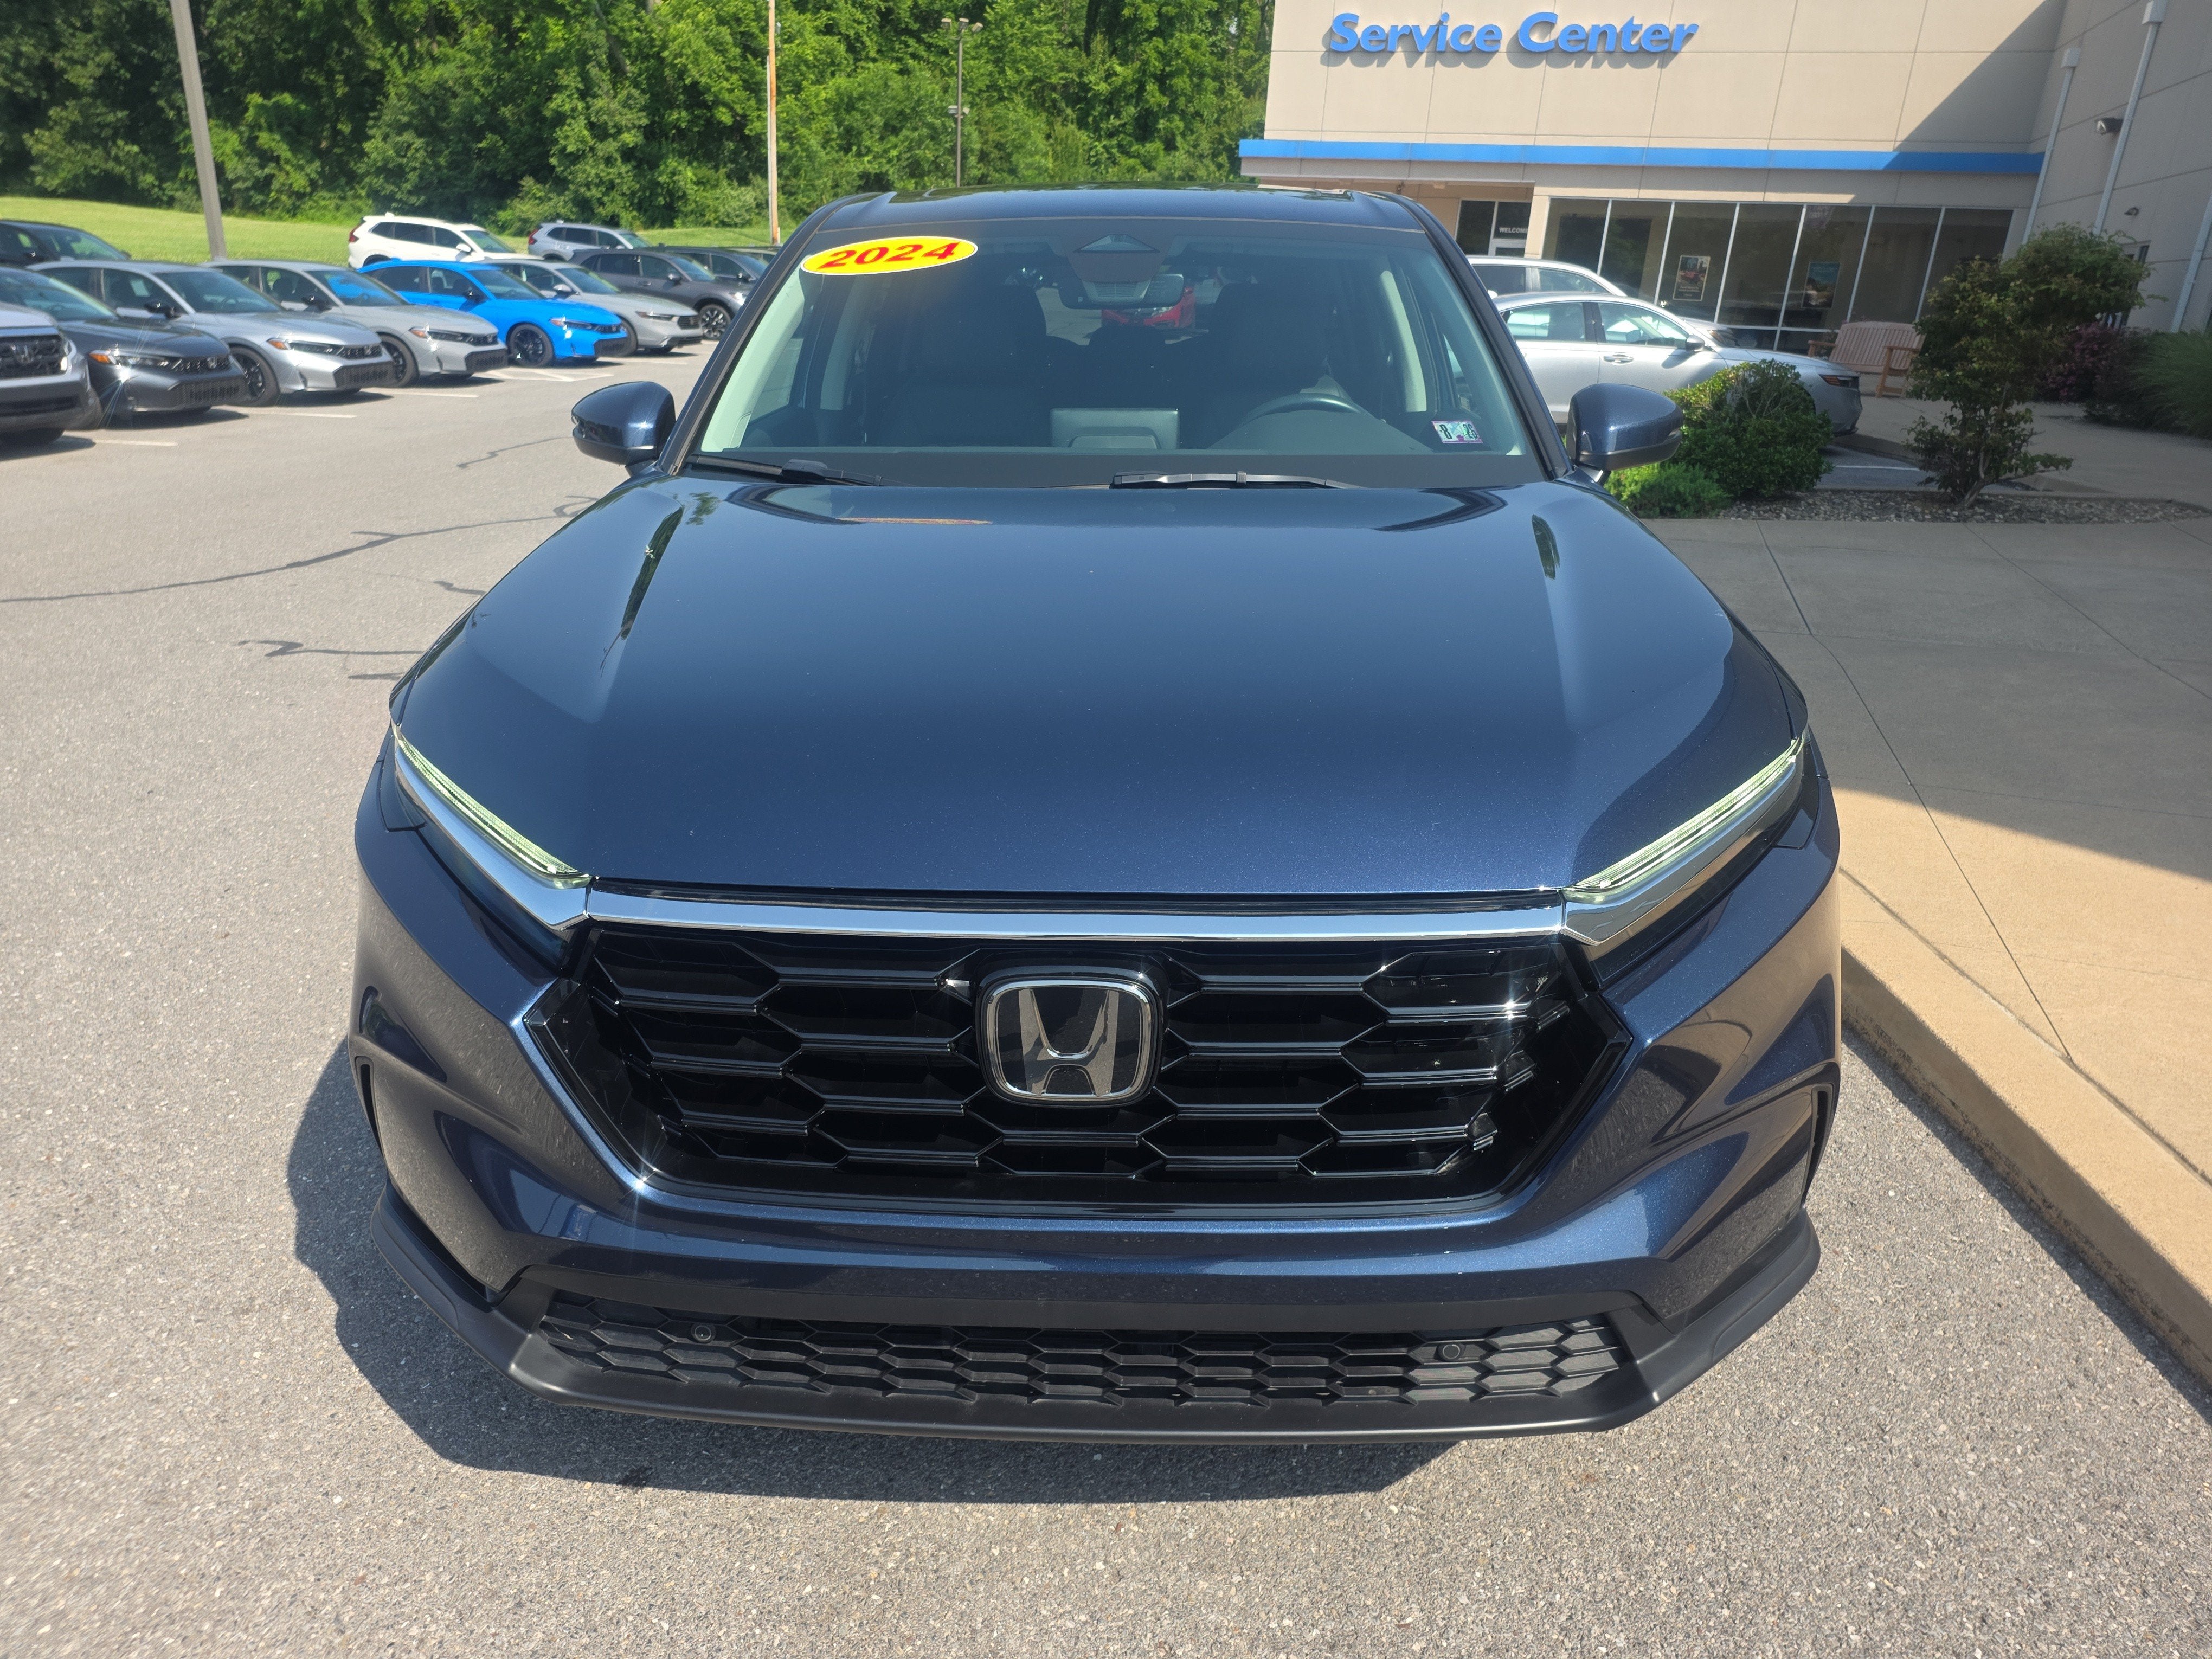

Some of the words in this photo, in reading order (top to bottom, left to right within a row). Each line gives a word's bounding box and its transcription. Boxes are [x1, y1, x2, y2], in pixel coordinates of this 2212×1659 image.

[1330, 12, 1502, 52] Service
[1519, 11, 1699, 53] Center
[816, 242, 960, 270] 2024
[1440, 424, 1452, 439] 8
[1462, 423, 1478, 440] 26
